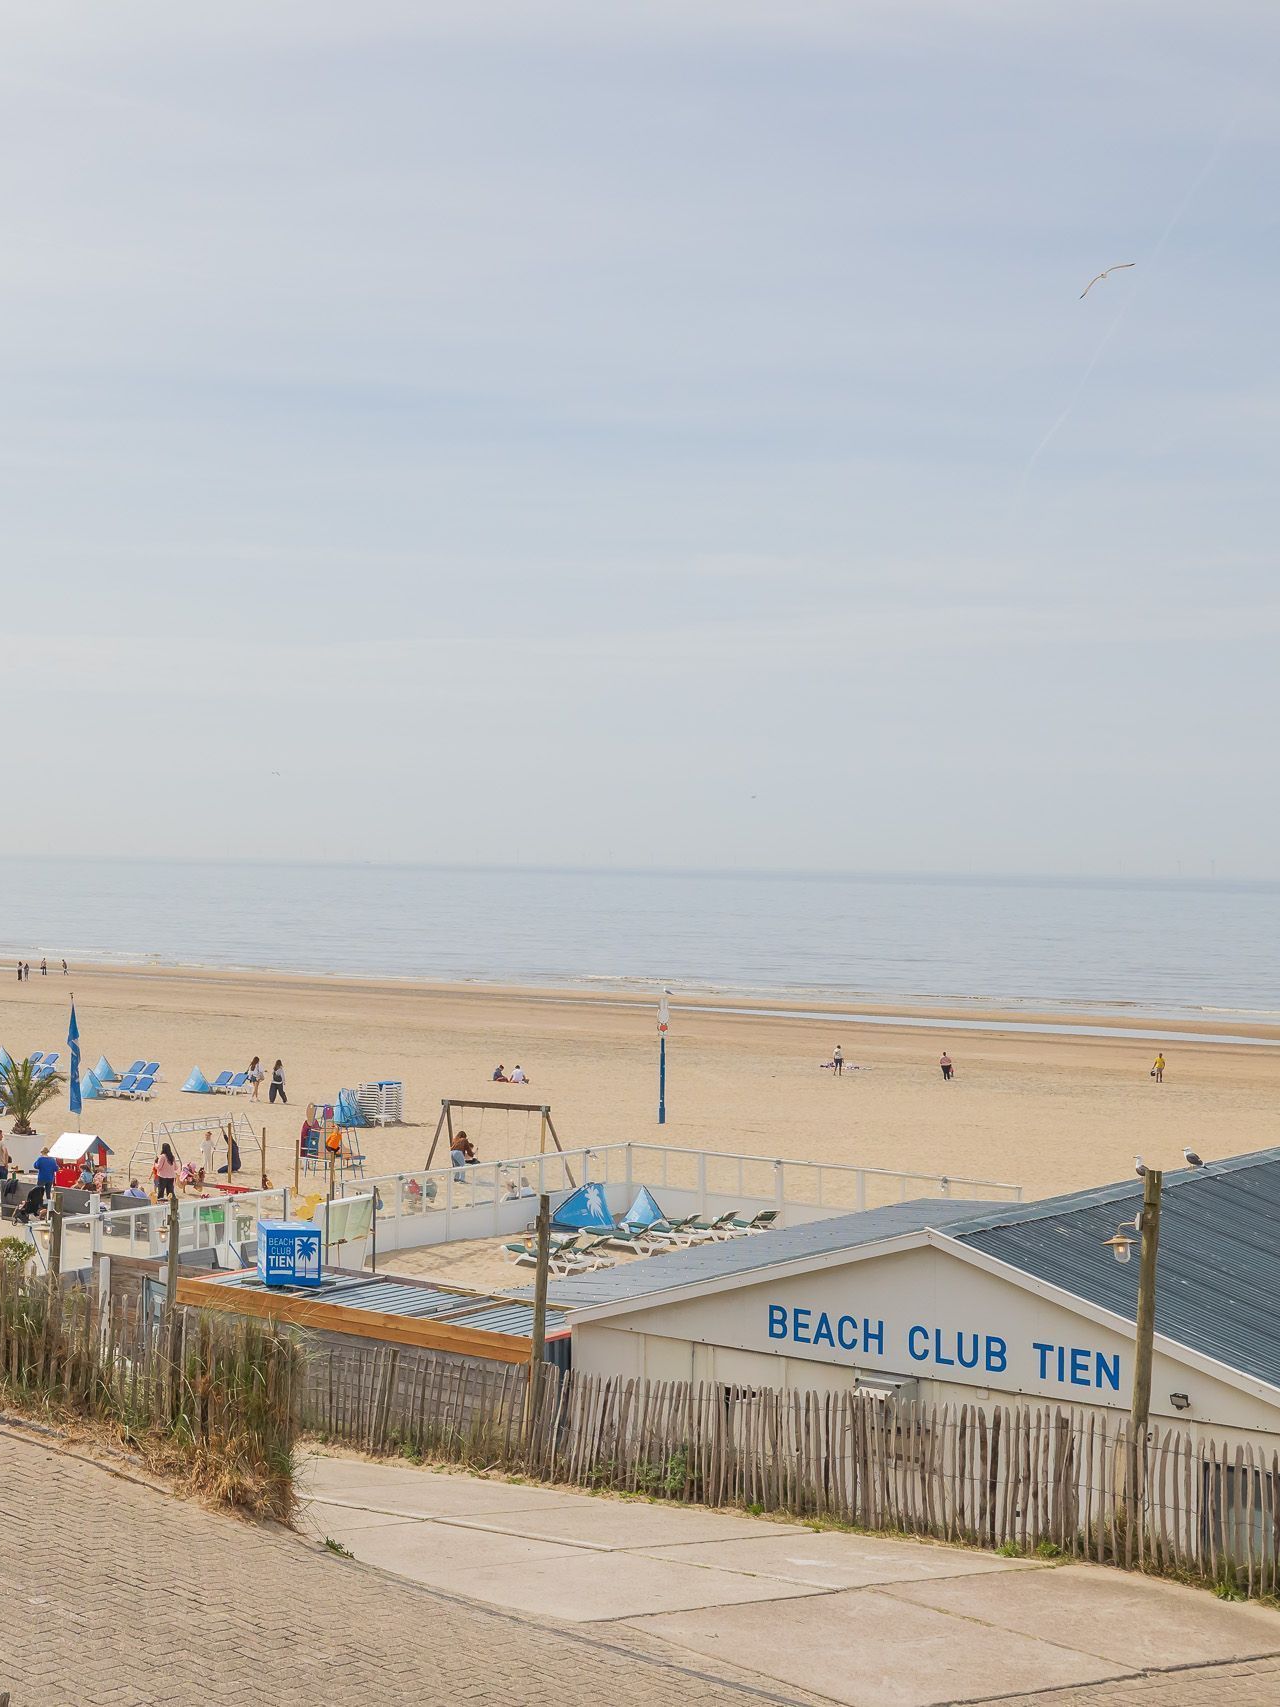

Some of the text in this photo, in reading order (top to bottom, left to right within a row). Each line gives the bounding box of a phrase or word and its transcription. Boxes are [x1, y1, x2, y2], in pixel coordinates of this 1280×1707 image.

[268, 1237, 294, 1246] BEACH
[271, 1246, 292, 1255] CLUB
[268, 1255, 294, 1268] TIEN
[768, 1304, 1121, 1391] BEACH CLUB TIEN
